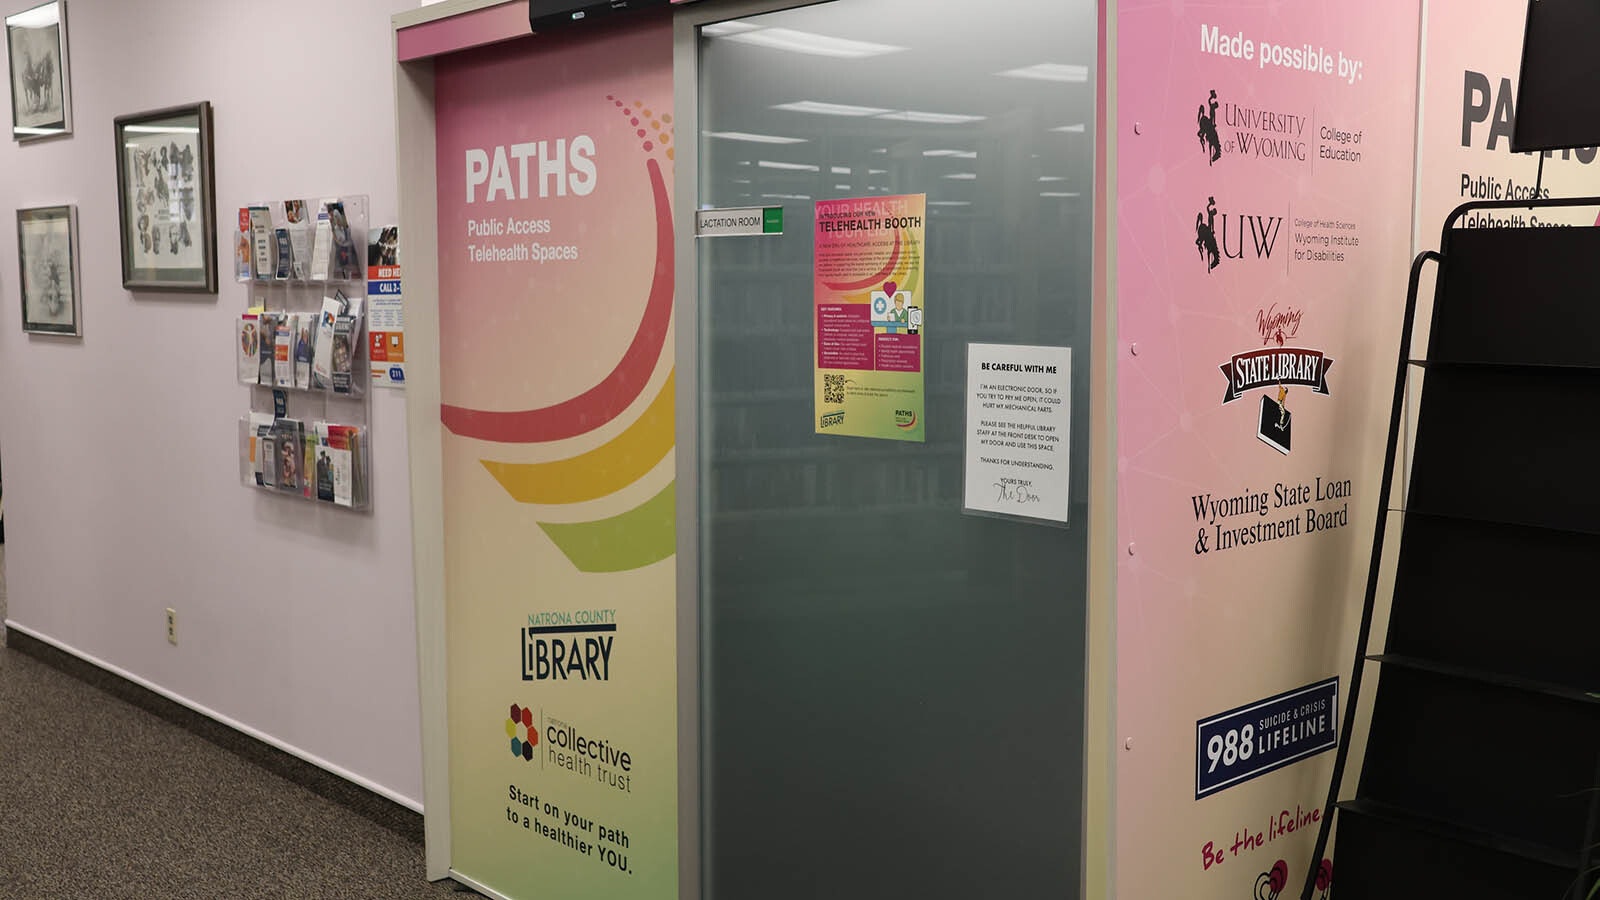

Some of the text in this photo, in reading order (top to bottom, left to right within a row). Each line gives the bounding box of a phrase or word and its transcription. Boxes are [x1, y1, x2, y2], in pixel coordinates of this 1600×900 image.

[1201, 24, 1364, 84] Made possible by:
[1225, 104, 1306, 137] UNIVERSITY
[1224, 132, 1306, 161] OF WYOMING
[1320, 126, 1362, 145] College of
[1320, 145, 1361, 162] Education
[466, 135, 597, 203] PATHS
[1460, 173, 1550, 201] Public Access
[468, 216, 551, 237] Public Access
[700, 218, 736, 228] LACTATION
[738, 216, 760, 226] ROOM
[820, 216, 921, 232] TELEHEALTH BOOTH
[1294, 218, 1312, 229] College
[1222, 214, 1284, 260] UW
[1294, 233, 1359, 247] Wyoming Institute
[468, 242, 578, 264] Telehealth Spaces
[1294, 249, 1345, 262] for Disabilities
[378, 268, 392, 278] NEED
[379, 282, 392, 293] CALL
[1256, 302, 1304, 346] Wyoming
[981, 362, 1056, 374] BE CAREFUL WITH ME
[1236, 353, 1320, 389] STATE LIBRARY
[1004, 404, 1036, 412] MECHANICAL
[980, 420, 997, 428] PLEASE
[980, 456, 1000, 464] THANKS
[993, 482, 1040, 503] The Door
[1192, 477, 1352, 525] Wyoming State Loan
[1194, 504, 1348, 554] & Investment Board
[528, 609, 616, 626] NATRONA COUNTY
[1259, 699, 1326, 731] SUICIDE & CRISIS
[547, 726, 632, 772] collective
[1207, 714, 1326, 774] 988 LIFELINE
[549, 745, 632, 793] health trust
[509, 784, 630, 849] Start on your path
[506, 806, 632, 875] to a healthier YOU.
[1202, 841, 1224, 871] Be
[1230, 828, 1264, 857] the
